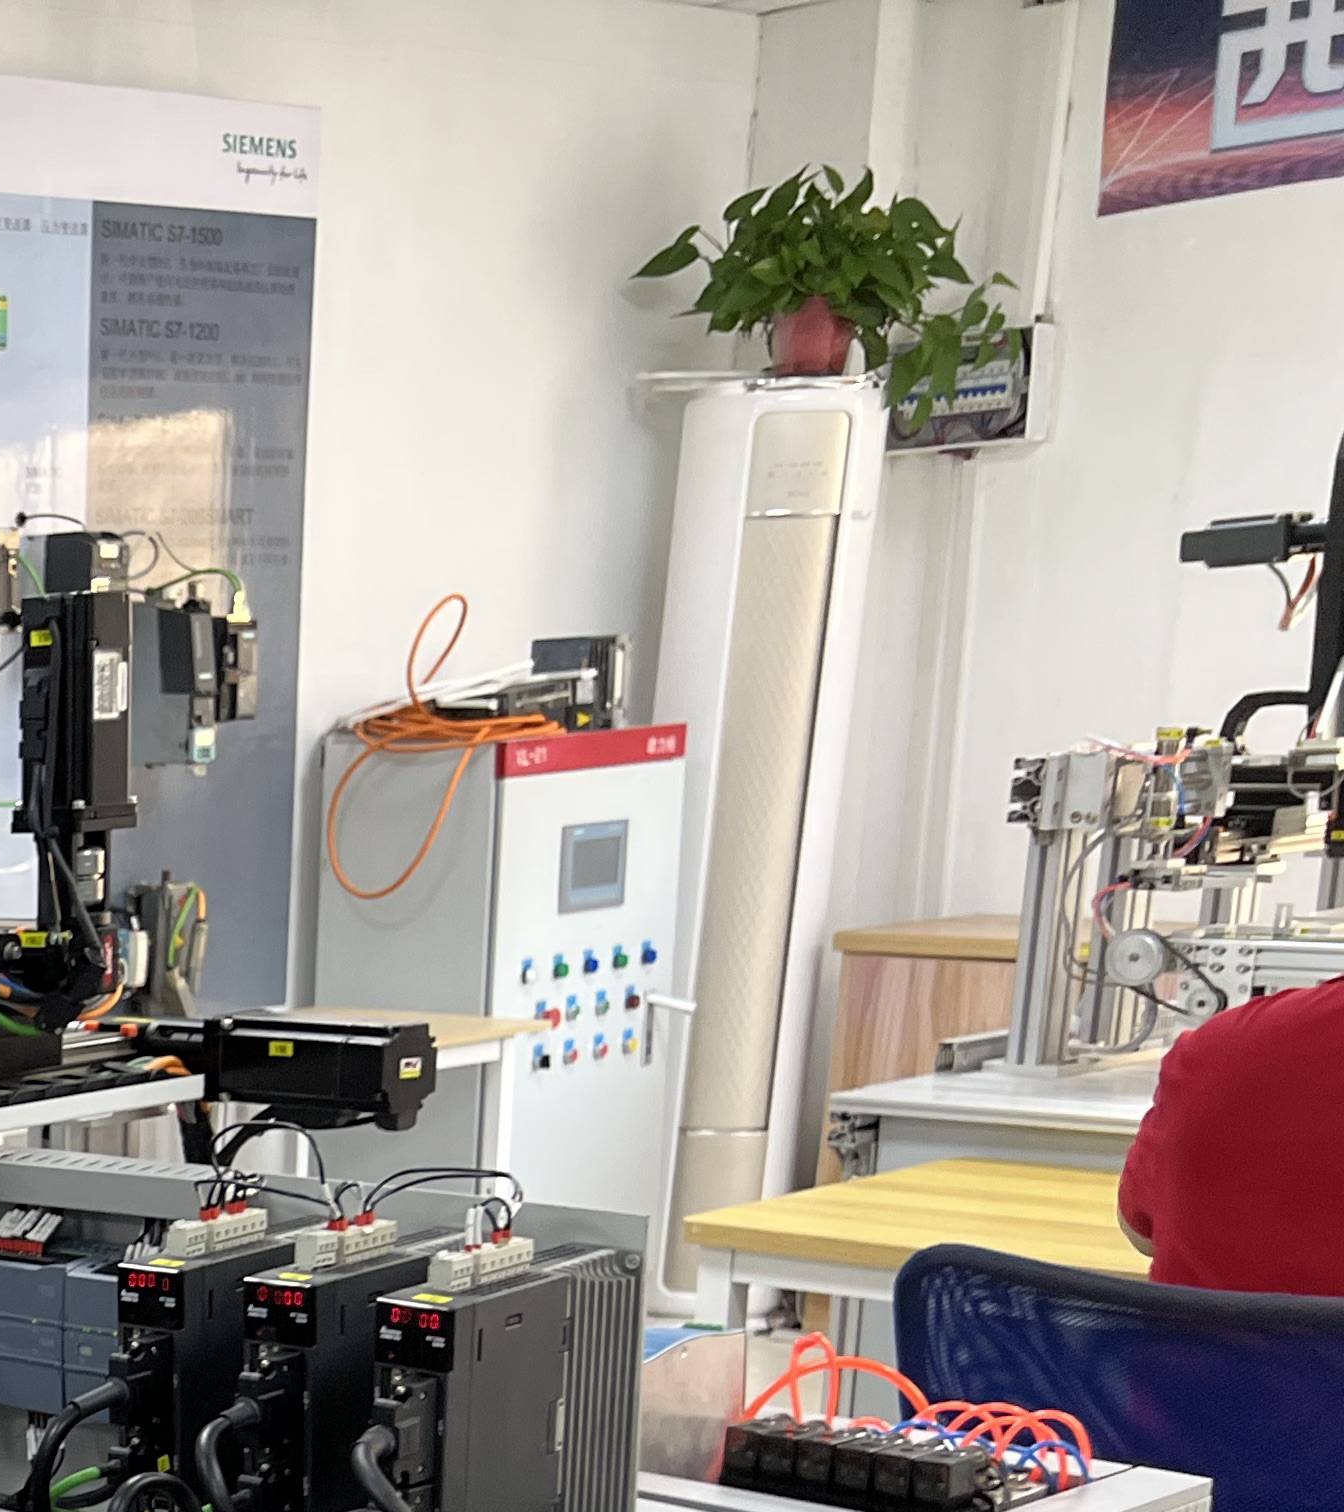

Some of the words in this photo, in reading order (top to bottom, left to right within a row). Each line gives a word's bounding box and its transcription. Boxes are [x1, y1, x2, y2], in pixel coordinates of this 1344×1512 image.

[222, 132, 297, 159] SIEMENS
[100, 220, 163, 242] SIMATIC
[167, 224, 224, 246] S7-1500
[99, 317, 160, 338] SIMATIC
[164, 319, 220, 341] S7-1200
